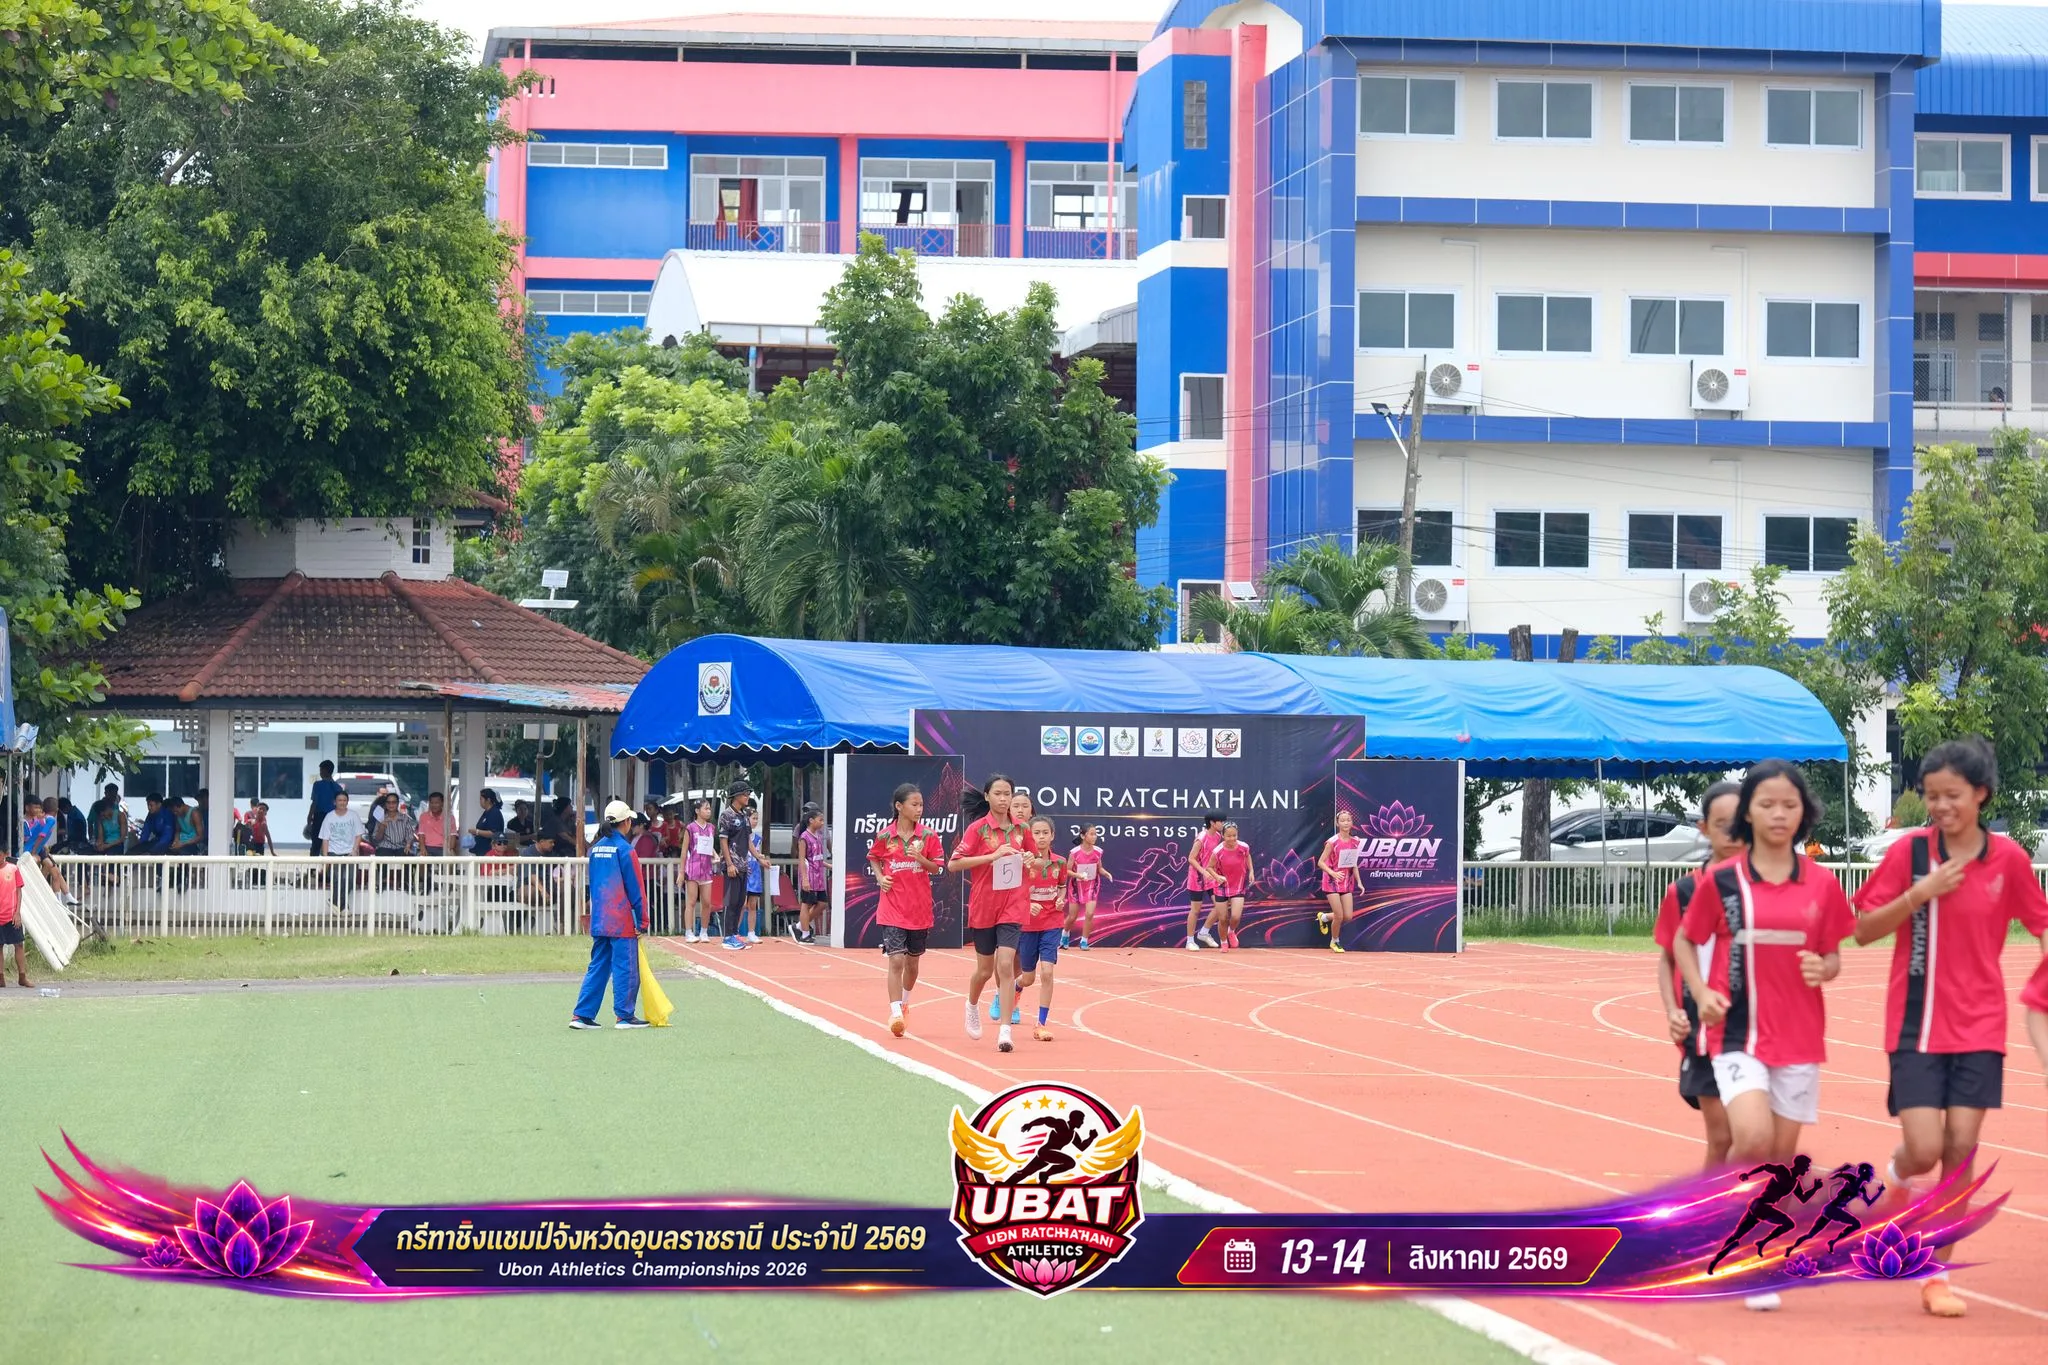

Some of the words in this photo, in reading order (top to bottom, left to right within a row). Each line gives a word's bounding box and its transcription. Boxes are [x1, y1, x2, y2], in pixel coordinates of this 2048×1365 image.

[1097, 788, 1298, 809] RATCHATHANI
[1358, 838, 1442, 857] UBON
[1358, 858, 1438, 869] ATHLETICS
[1002, 862, 1014, 885] 5
[1727, 1063, 1746, 1082] 2
